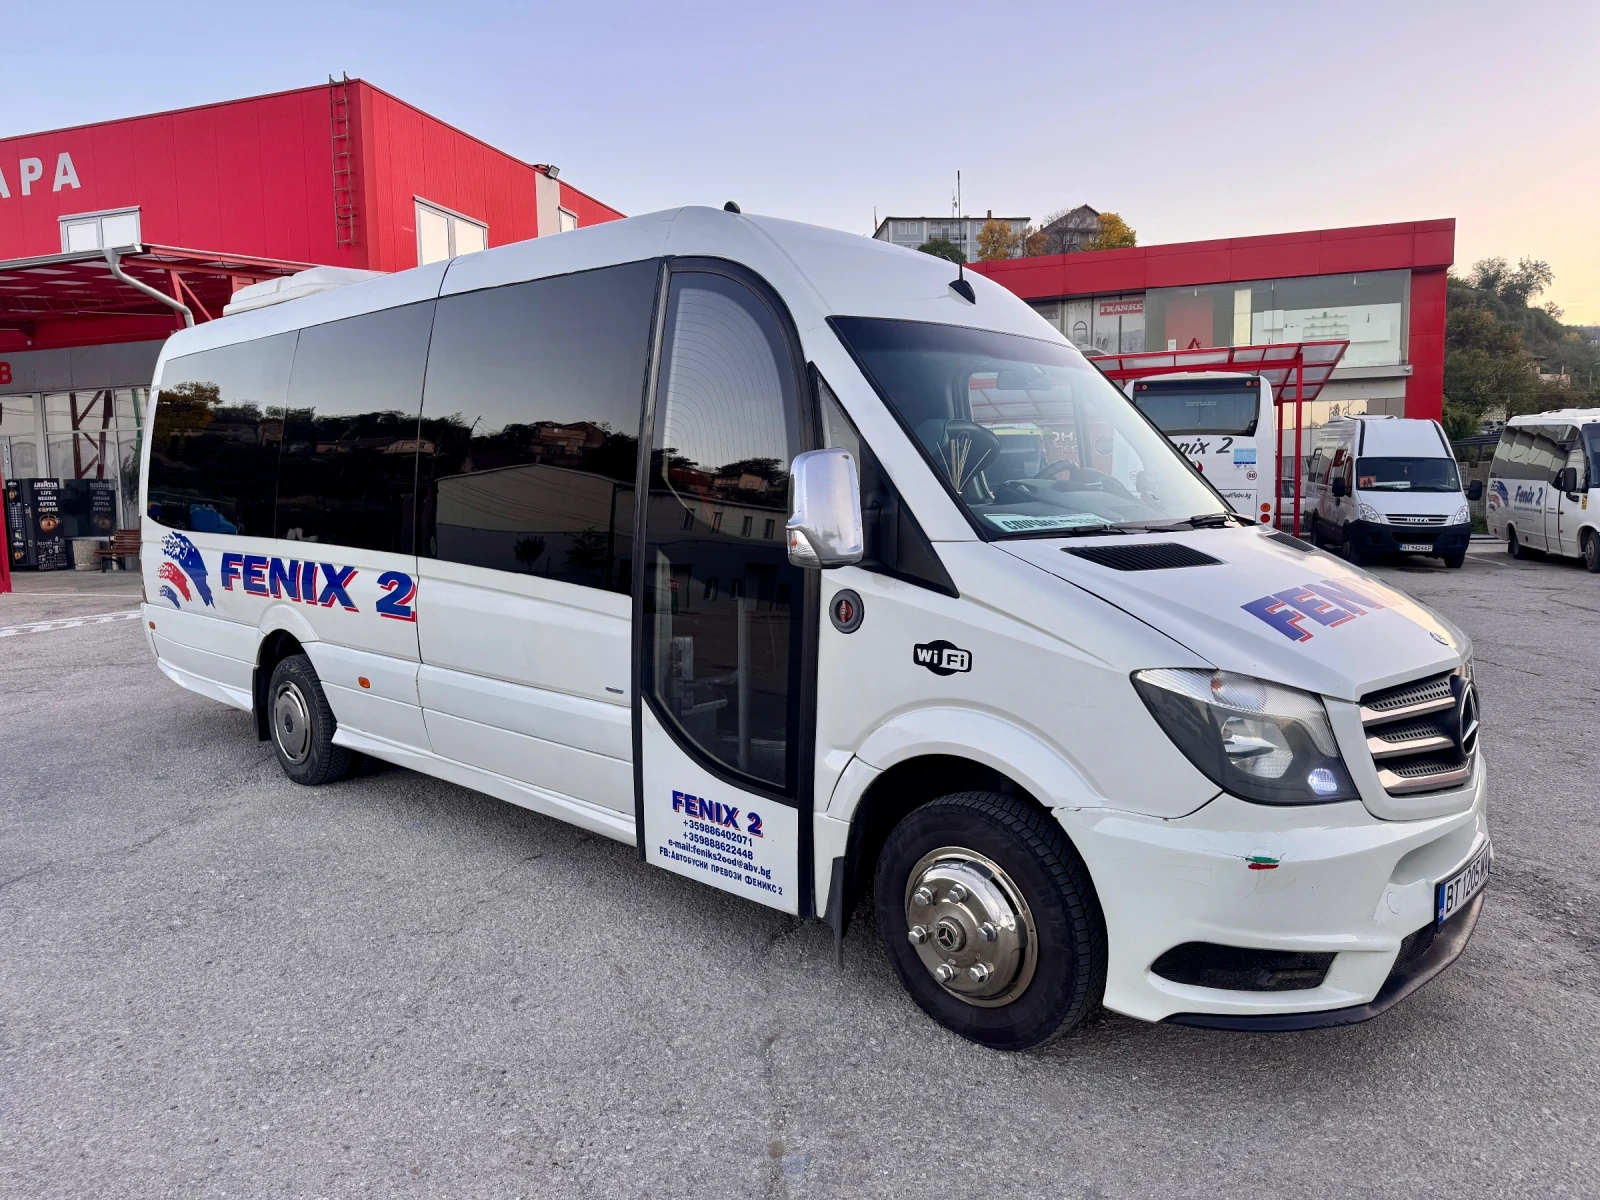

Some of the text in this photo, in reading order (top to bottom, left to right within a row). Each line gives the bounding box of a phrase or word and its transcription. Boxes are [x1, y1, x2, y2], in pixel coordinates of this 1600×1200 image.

[1101, 304, 1143, 313] FRANKE
[1216, 437, 1233, 454] 2
[1536, 487, 1543, 506] 2
[221, 552, 417, 623] FENIX 2
[672, 790, 764, 838] FENIX 2
[683, 819, 753, 847] +359886402071
[683, 832, 754, 860] +359888622448
[778, 887, 783, 895] 2
[1446, 877, 1461, 914] BT
[1463, 859, 1480, 900] 1205
